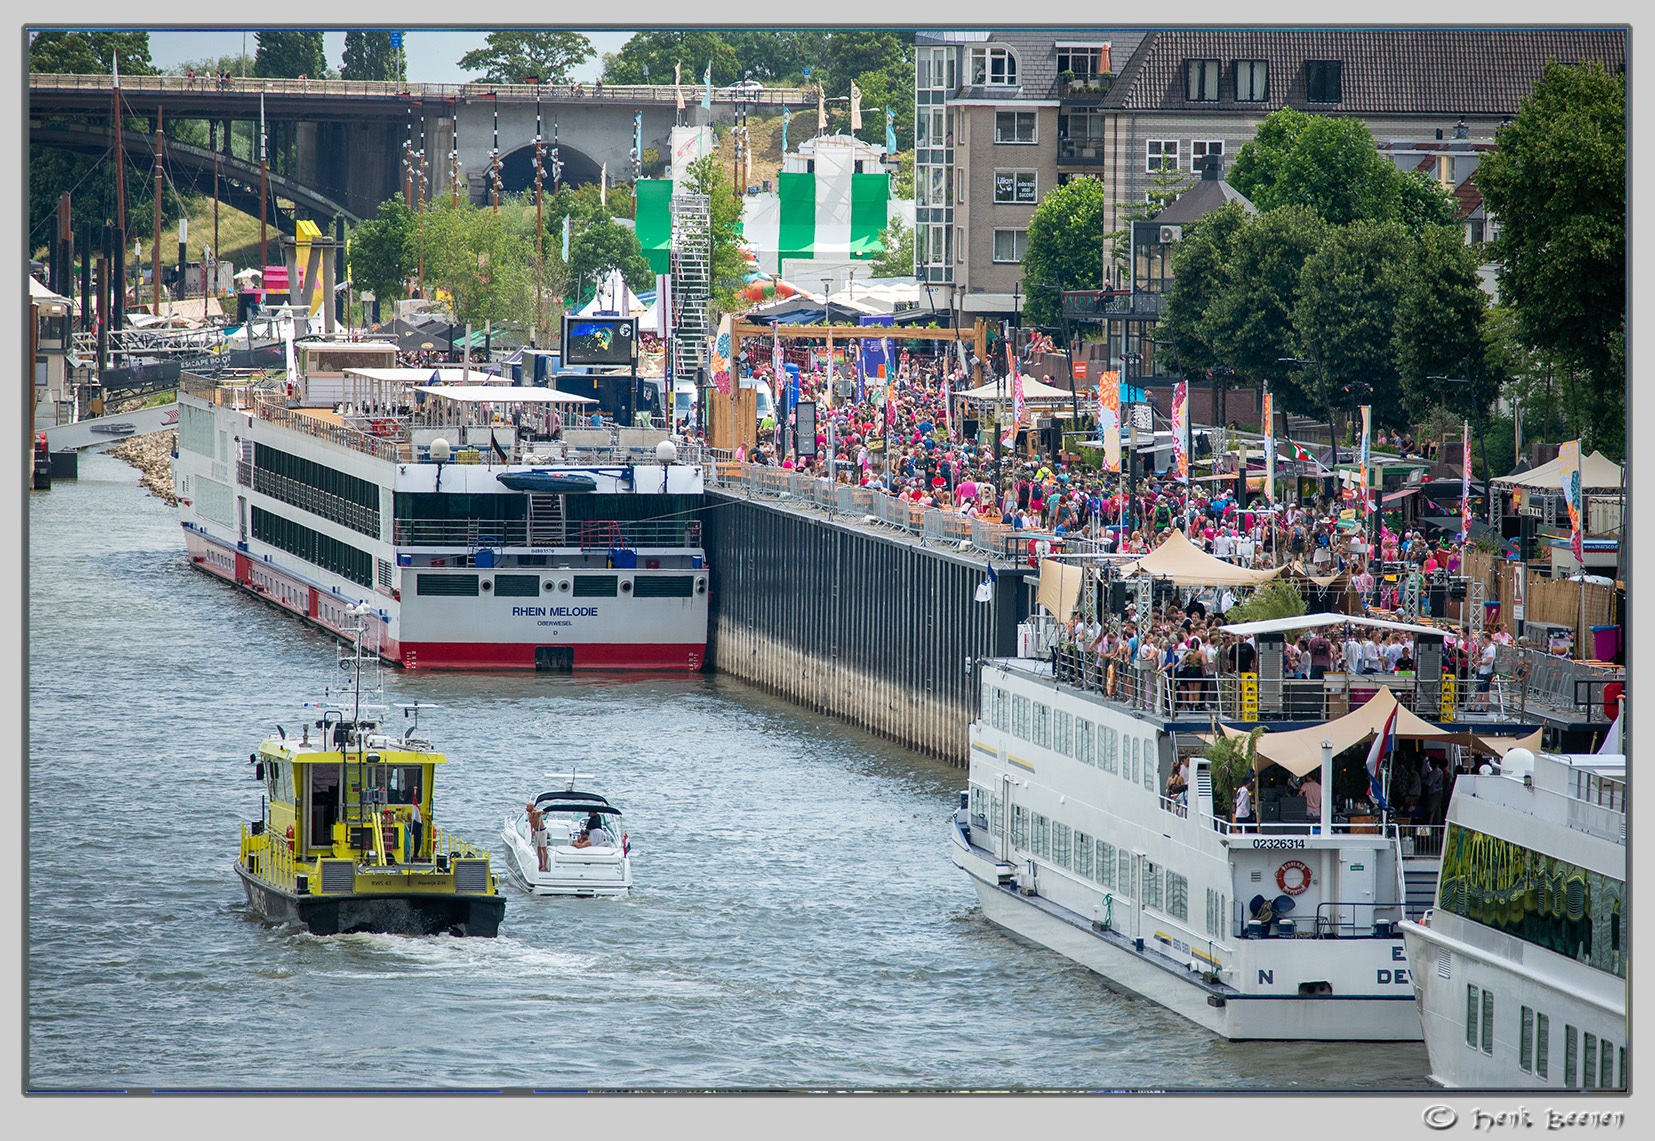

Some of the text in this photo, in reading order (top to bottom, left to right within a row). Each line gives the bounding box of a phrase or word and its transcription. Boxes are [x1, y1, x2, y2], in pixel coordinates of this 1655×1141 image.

[181, 359, 209, 369] ESCAPE
[512, 607, 598, 617] RHEIN MELODIE
[1253, 839, 1305, 849] 02326314
[1258, 969, 1274, 985] N
